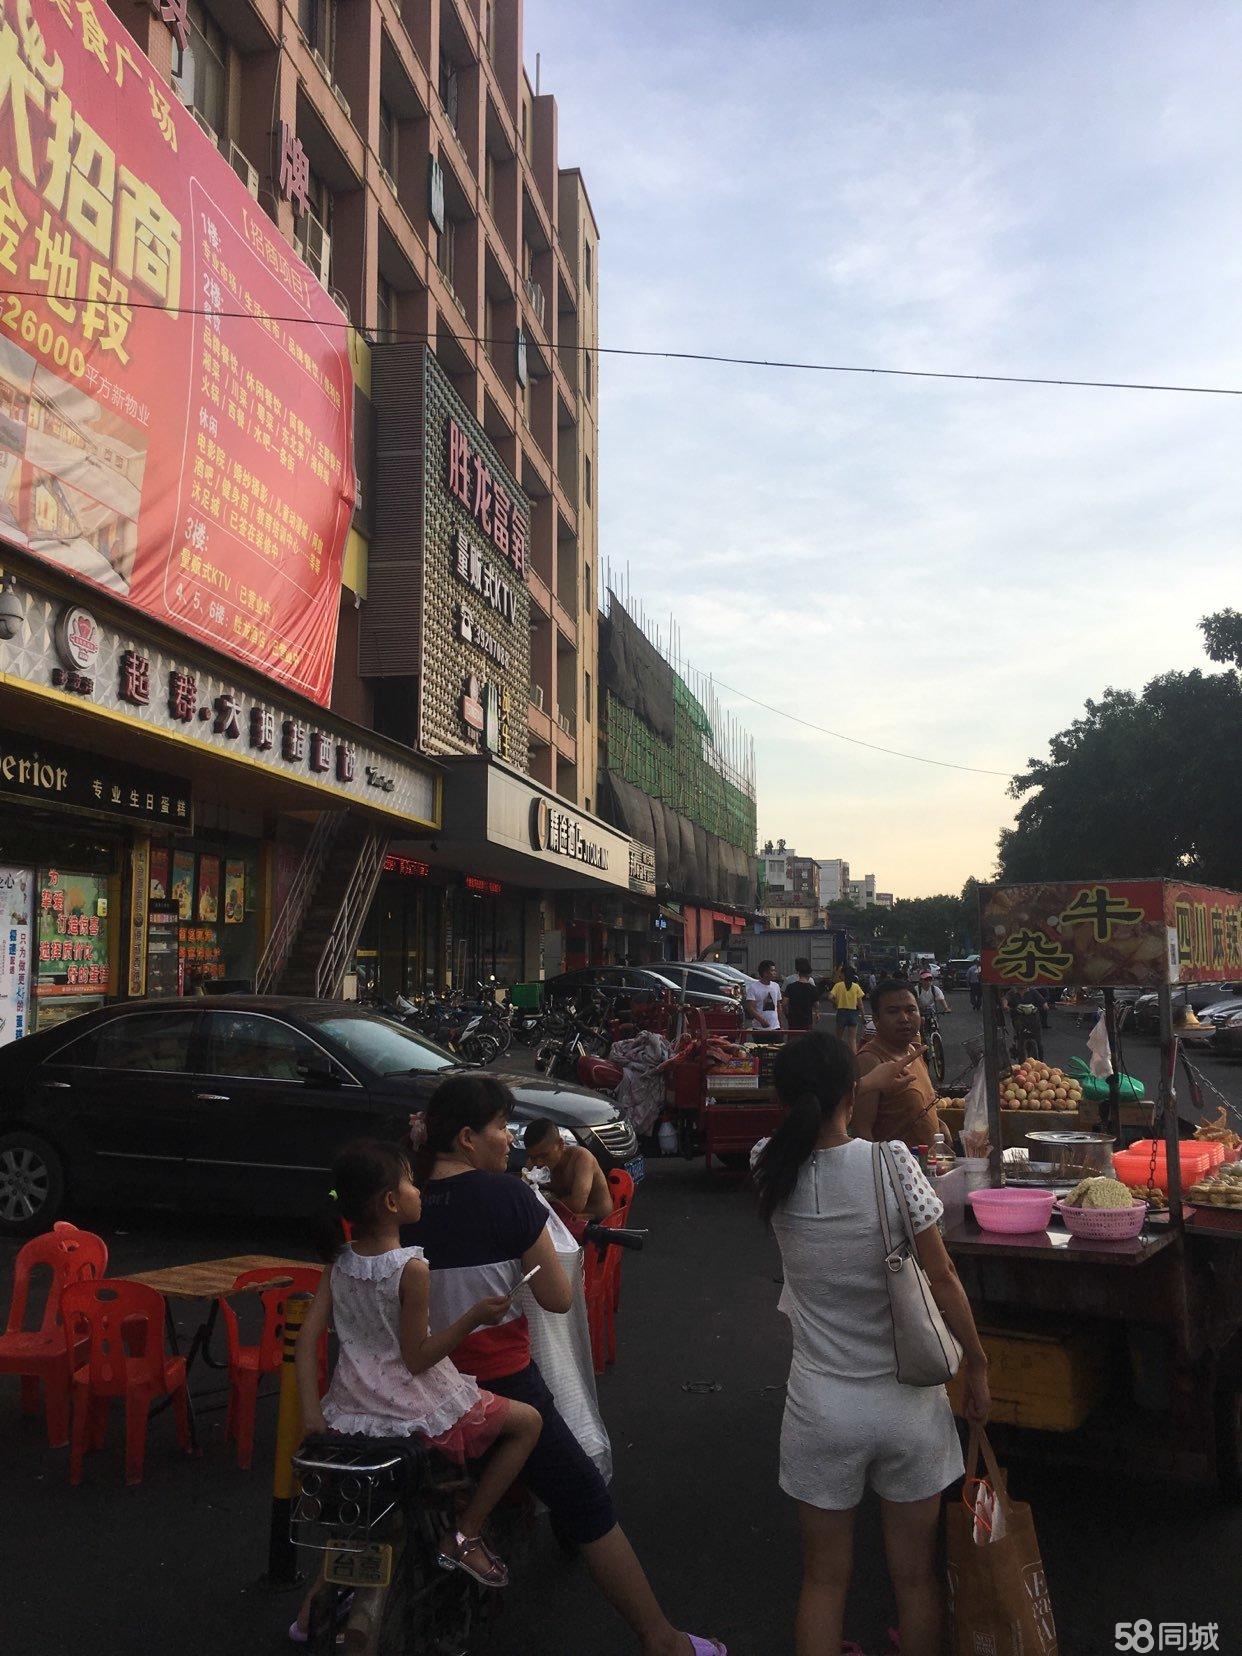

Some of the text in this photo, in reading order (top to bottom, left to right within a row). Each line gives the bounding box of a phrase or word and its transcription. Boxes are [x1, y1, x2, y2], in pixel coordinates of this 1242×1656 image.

[50, 0, 178, 153] 食广场
[85, 363, 151, 427] 平方新物业
[92, 779, 187, 818] 专业生日蛋糕
